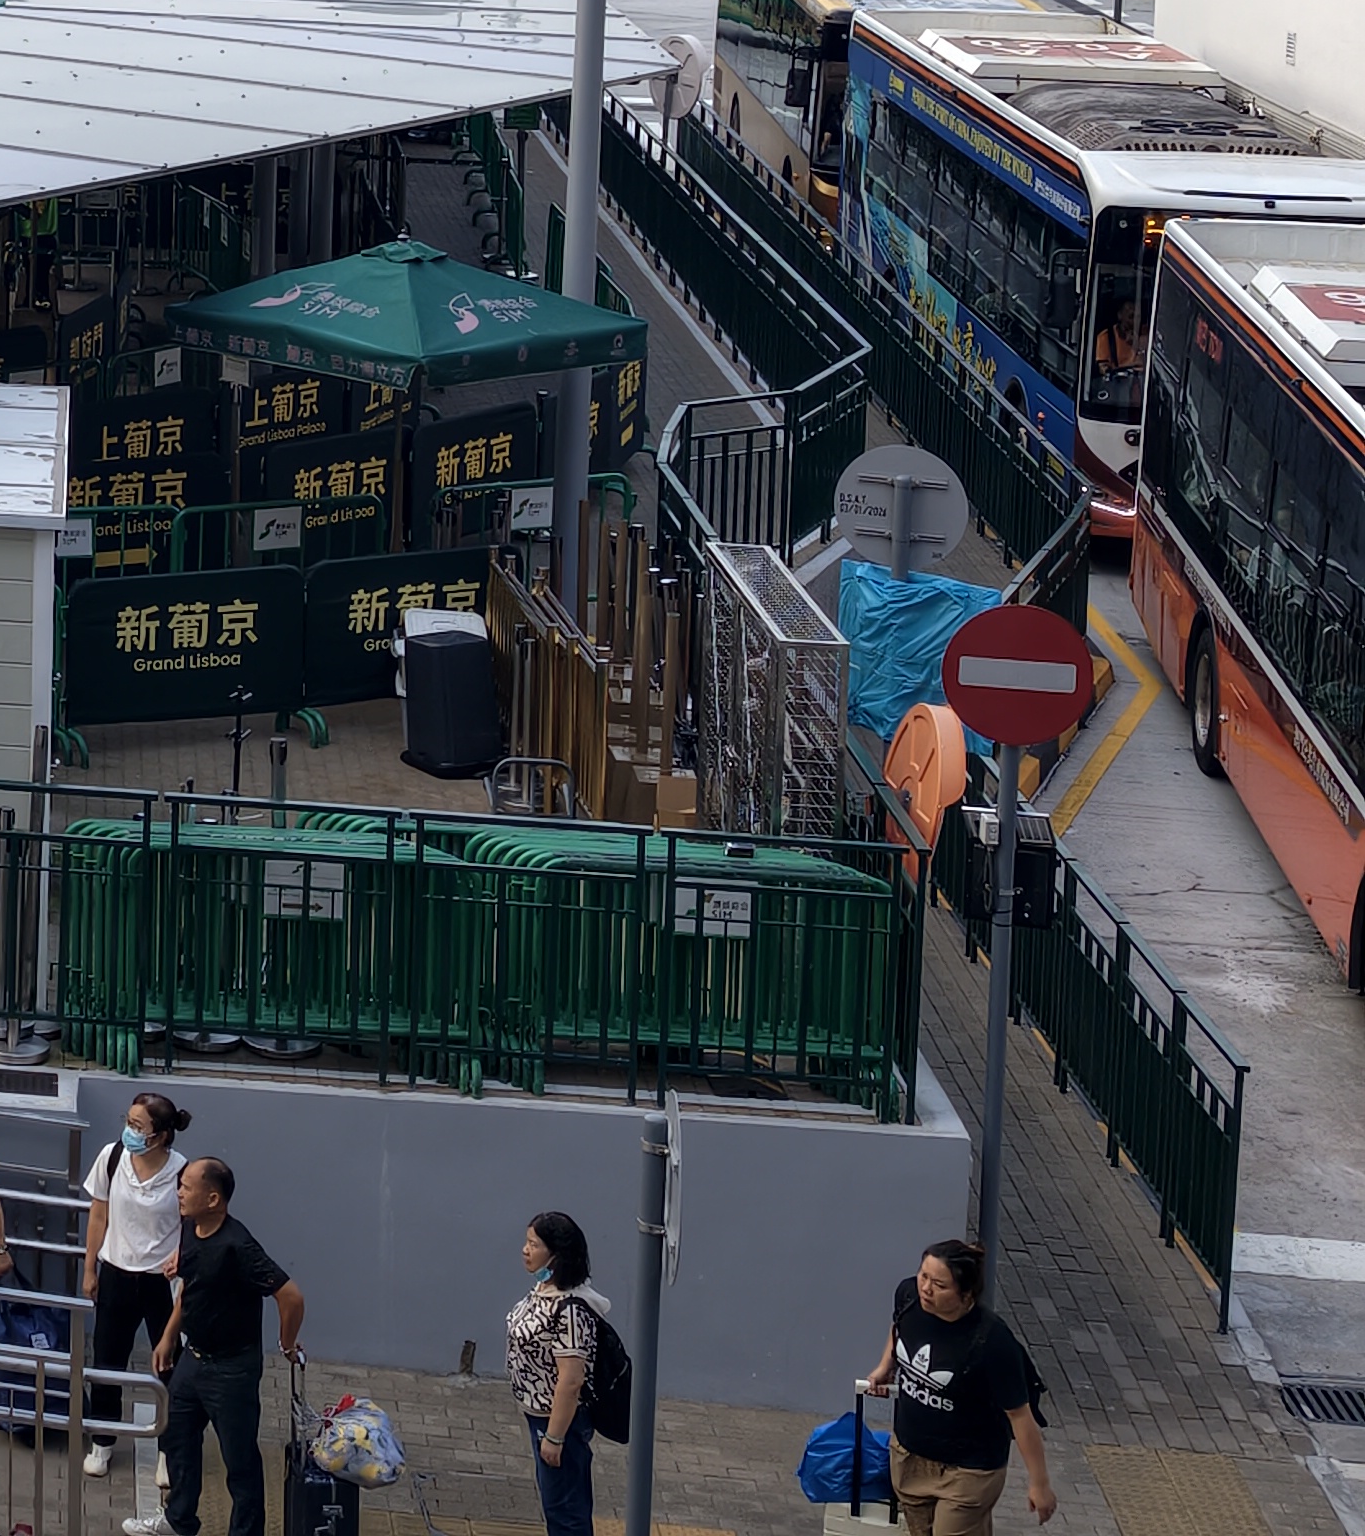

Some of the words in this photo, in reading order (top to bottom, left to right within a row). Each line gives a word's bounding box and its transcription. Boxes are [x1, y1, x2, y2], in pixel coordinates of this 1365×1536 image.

[299, 301, 340, 319] SJM
[245, 378, 321, 428] 上葡京
[92, 416, 185, 462] 上葡京
[268, 427, 295, 444] Lisboa
[294, 457, 388, 509] 新葡京
[436, 432, 513, 489] 新葡京
[68, 468, 188, 516] 新葡京
[116, 599, 259, 653] 新葡京
[348, 578, 480, 635] 新葡京
[133, 655, 185, 673] Grand
[189, 653, 241, 670] Lisboa
